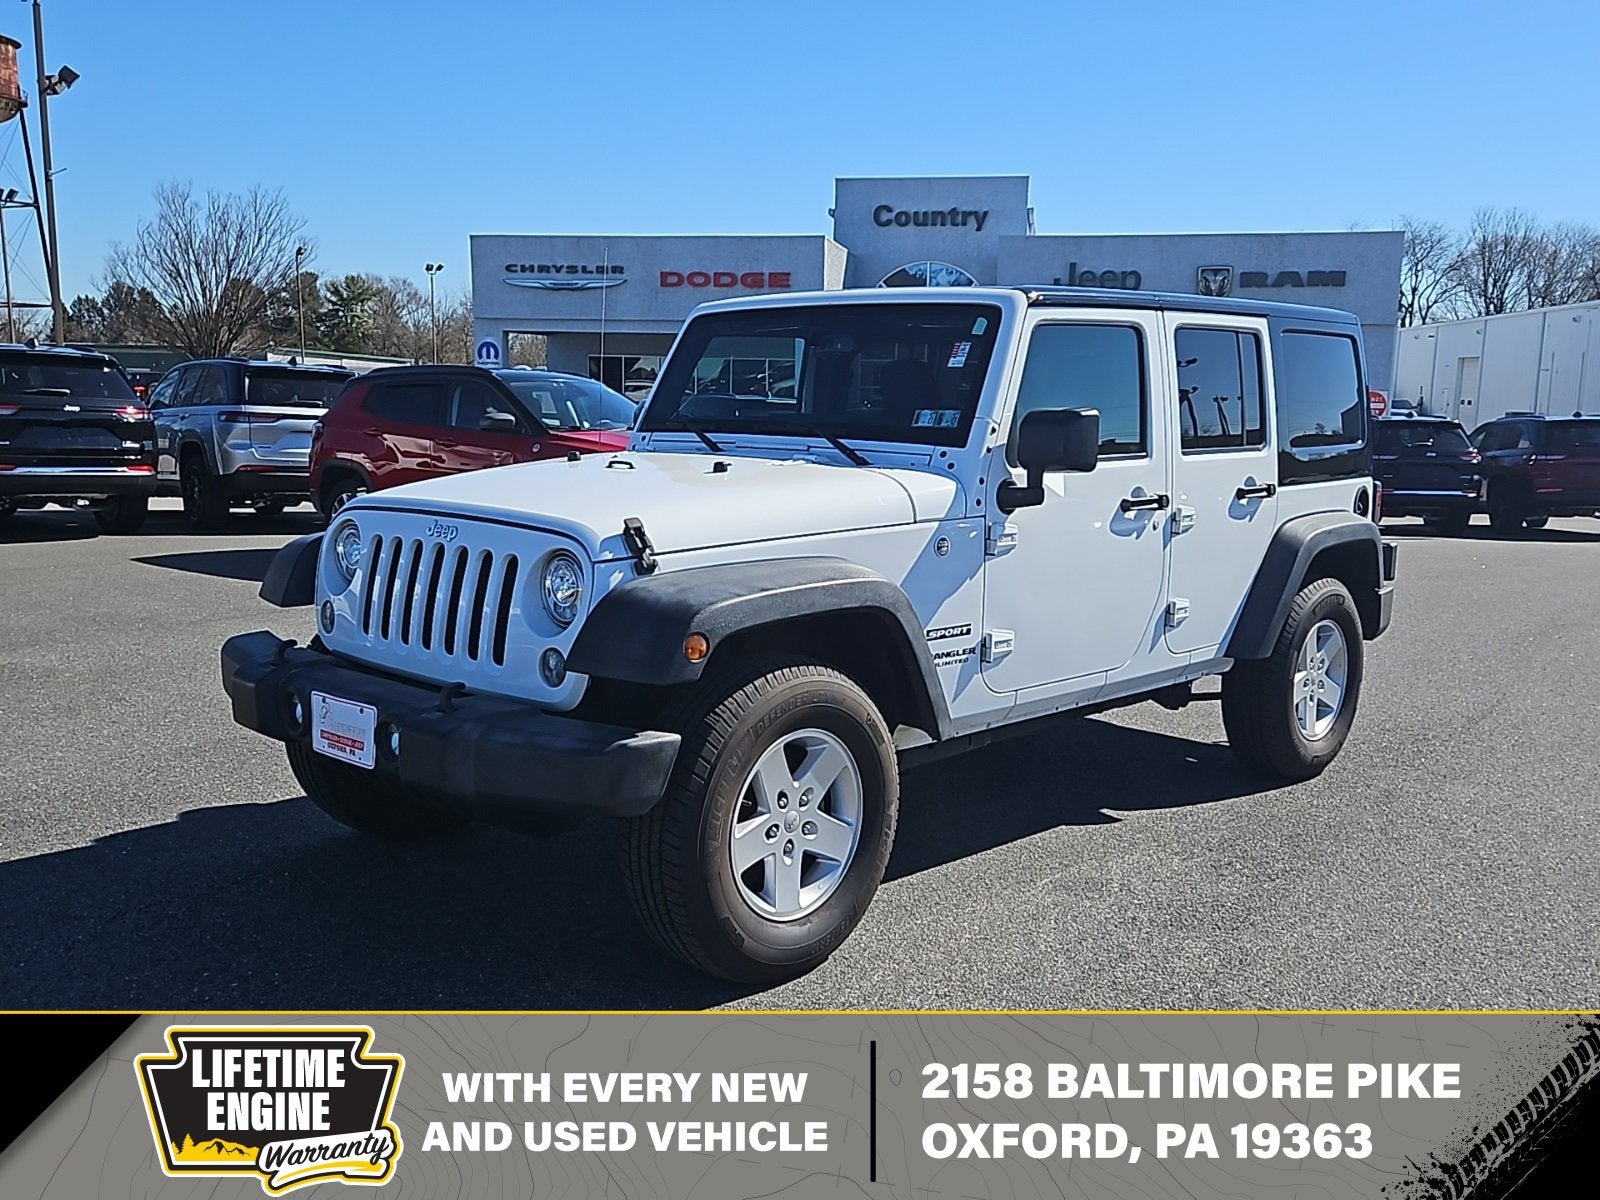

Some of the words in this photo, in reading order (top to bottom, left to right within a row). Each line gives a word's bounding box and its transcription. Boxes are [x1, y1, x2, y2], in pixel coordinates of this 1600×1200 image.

[873, 204, 989, 232] Country
[505, 263, 625, 275] CHRYSLER
[1053, 262, 1142, 290] Jeep
[660, 271, 791, 288] DODGE
[1239, 270, 1347, 288] RAM
[425, 519, 459, 543] Jeep
[927, 626, 969, 639] SPORT
[932, 646, 977, 660] ANGLER
